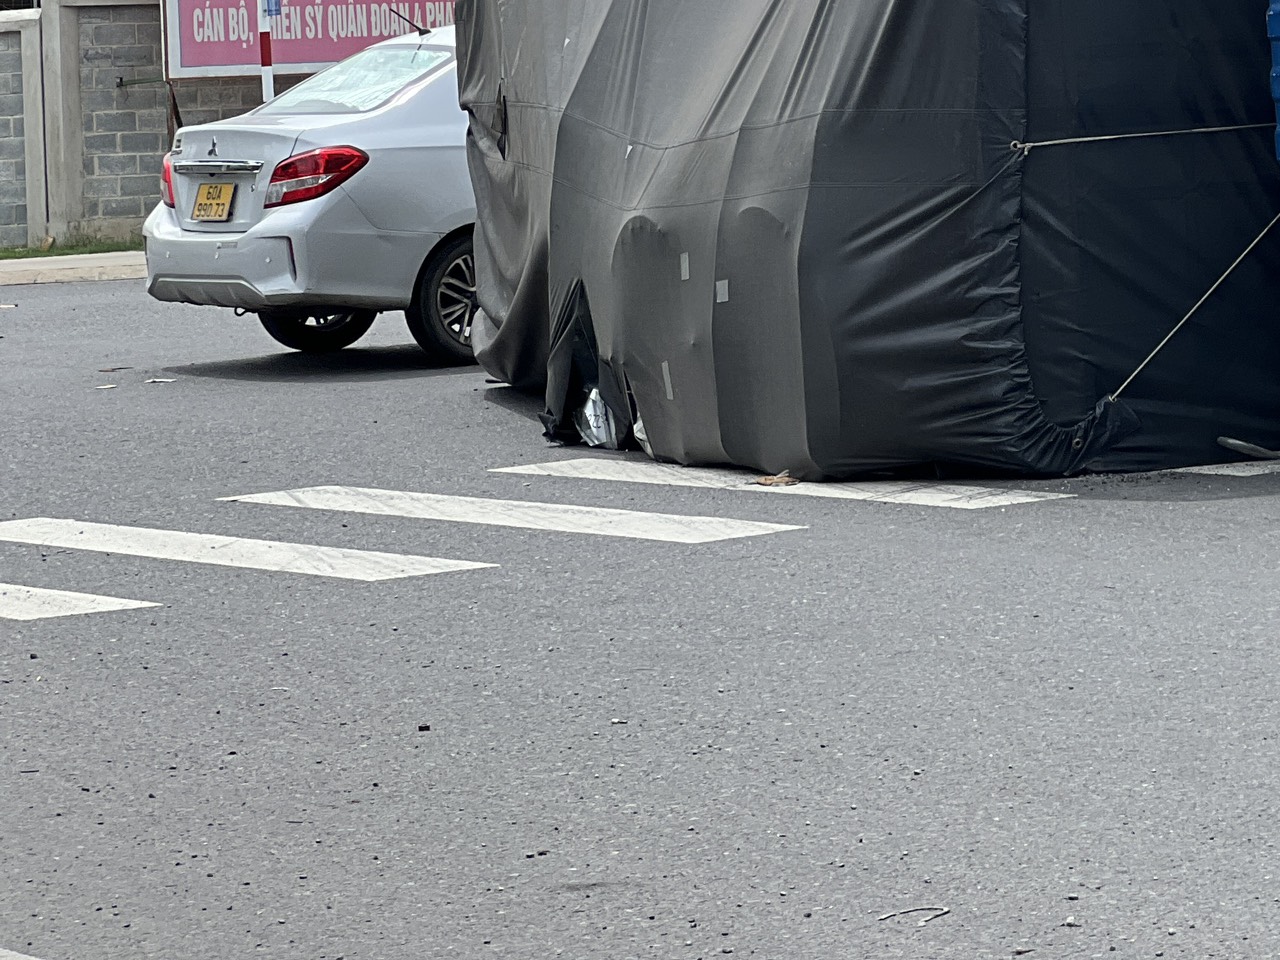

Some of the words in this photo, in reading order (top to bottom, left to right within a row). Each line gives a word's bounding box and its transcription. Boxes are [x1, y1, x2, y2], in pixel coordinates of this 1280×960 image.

[193, 0, 225, 43] CÁN
[228, 0, 254, 49] BỘ,
[414, 2, 423, 29] 4
[206, 185, 222, 201] 60A
[196, 202, 226, 218] 990.73
